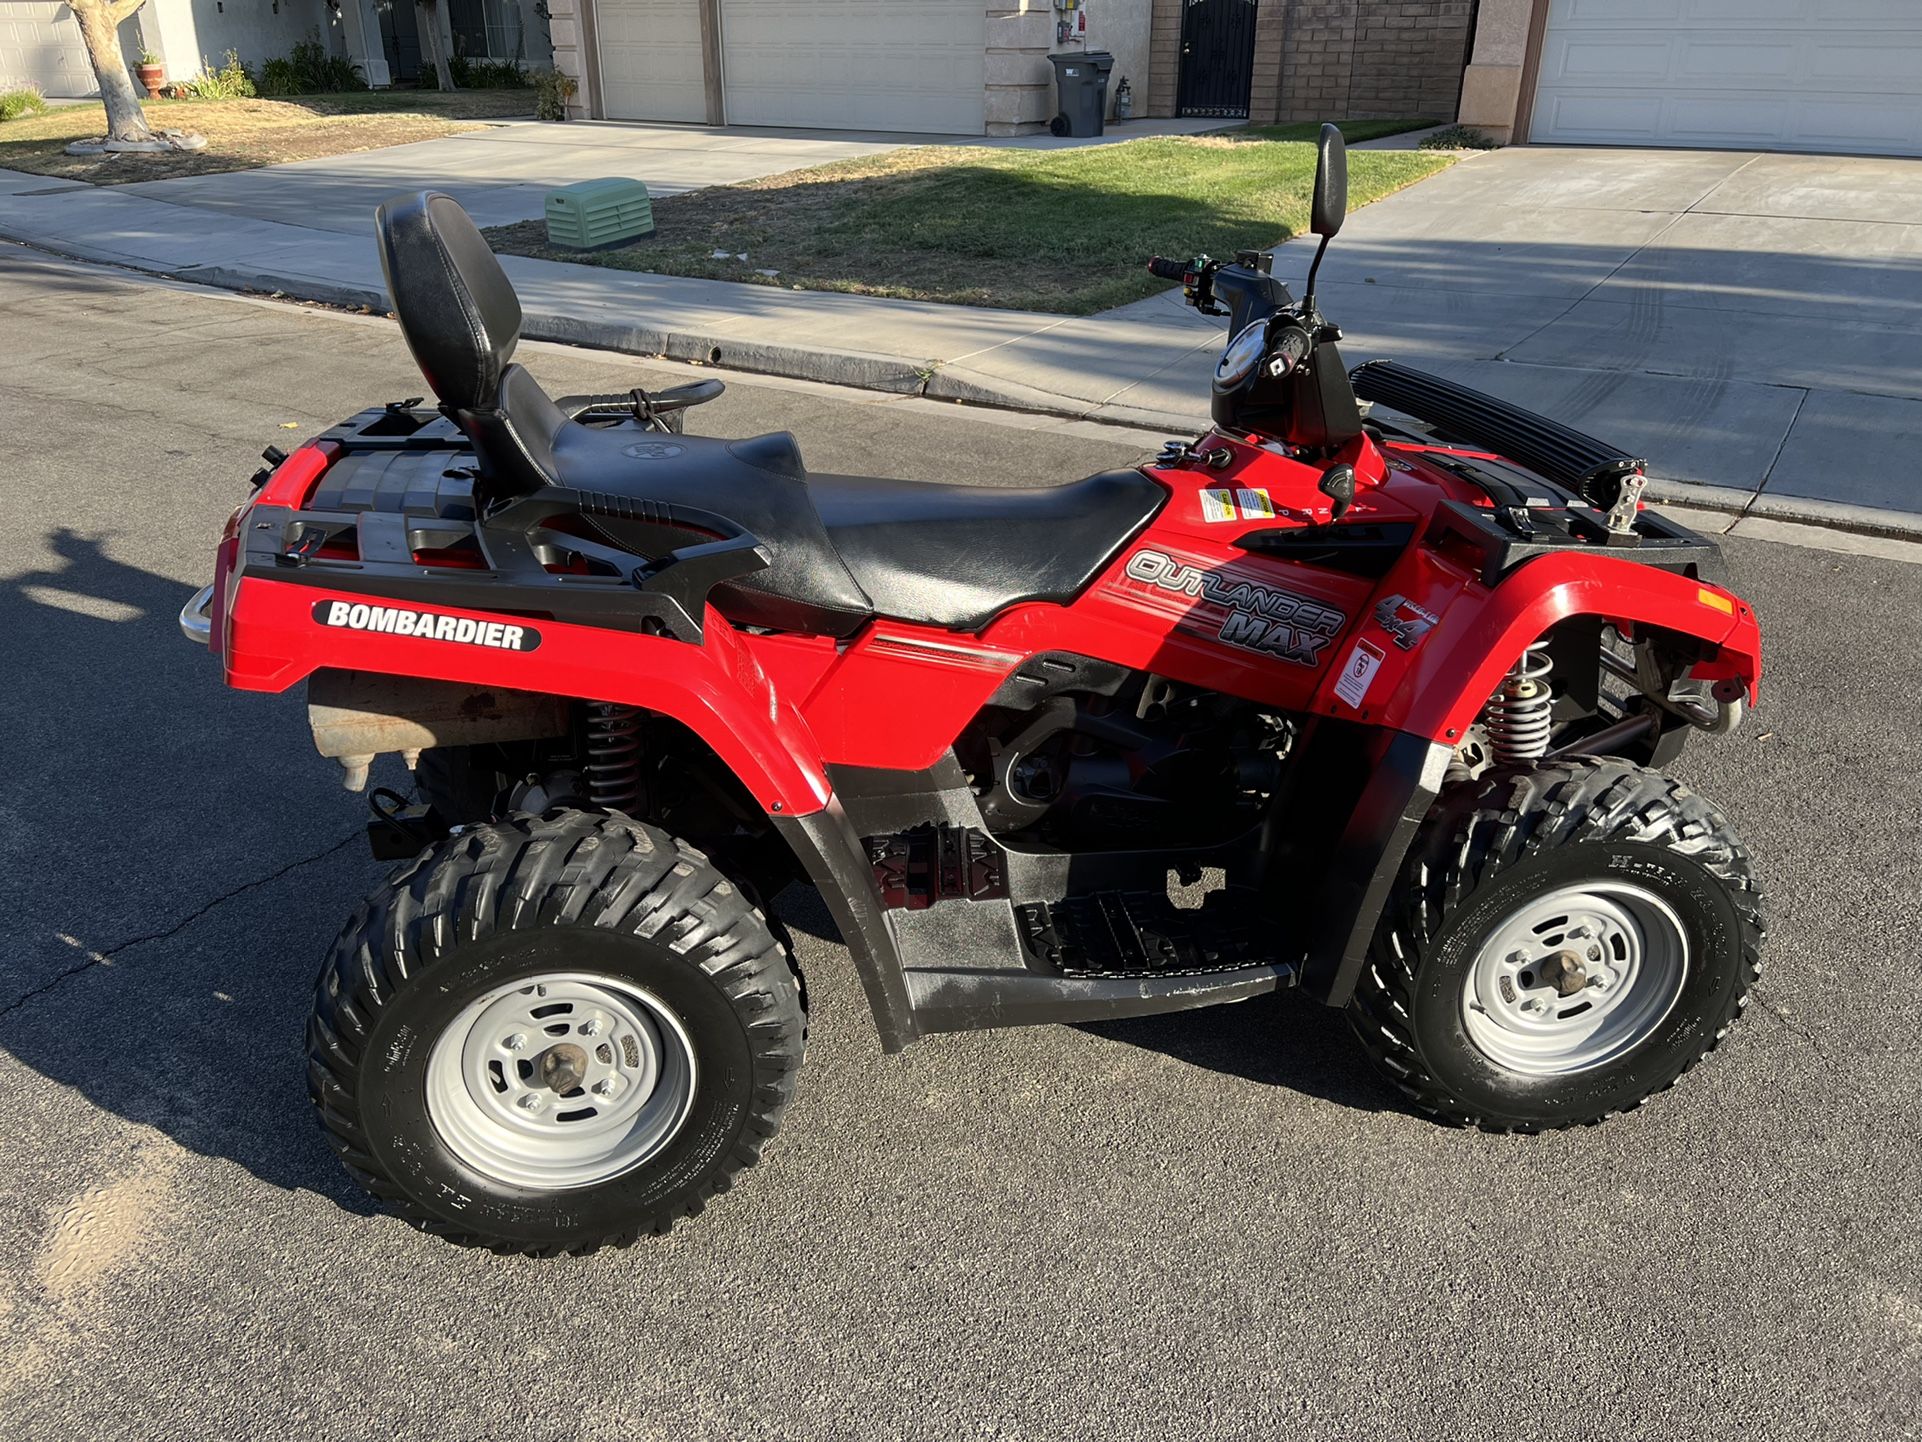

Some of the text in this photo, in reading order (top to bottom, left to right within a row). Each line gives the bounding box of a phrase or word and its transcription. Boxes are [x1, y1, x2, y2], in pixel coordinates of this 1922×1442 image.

[1302, 508, 1313, 516] R
[1125, 548, 1345, 637] OUTLANDER
[327, 601, 525, 650] BOMBARDIER
[1218, 611, 1331, 668] MAX
